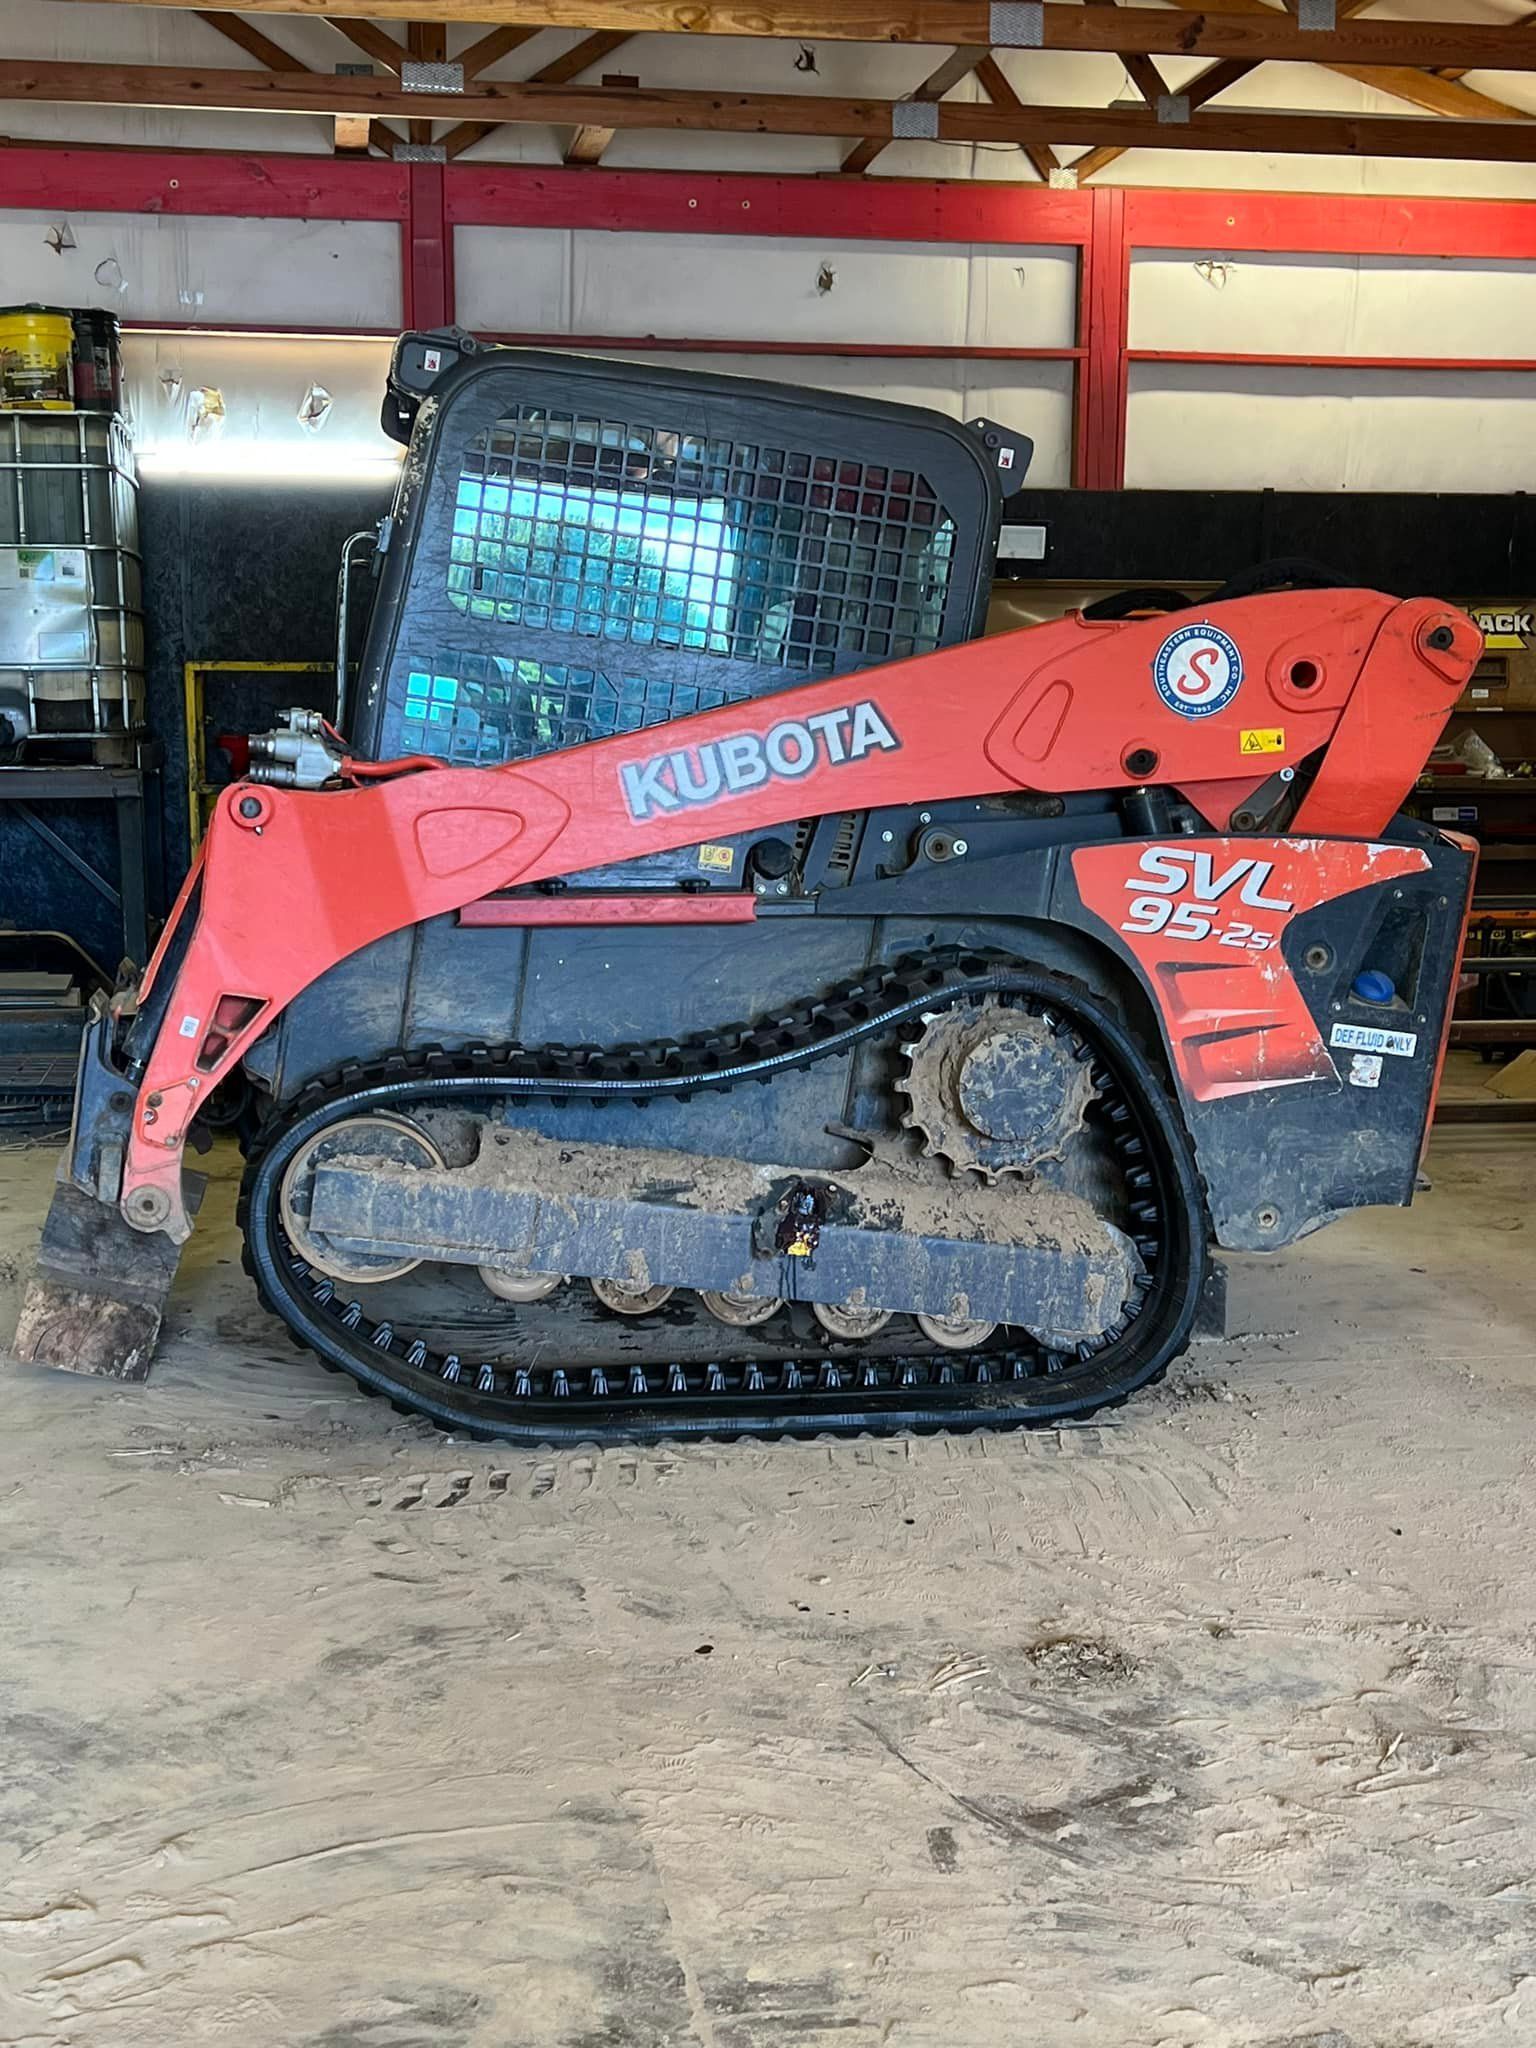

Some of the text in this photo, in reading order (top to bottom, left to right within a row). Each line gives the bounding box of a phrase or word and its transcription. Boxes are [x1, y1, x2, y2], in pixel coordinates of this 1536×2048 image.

[1472, 614, 1531, 633] ACK
[1158, 631, 1192, 698] SOUTHEASTERN
[1194, 628, 1238, 662] EQUIPMENT
[1177, 647, 1220, 696] S
[621, 701, 900, 819] KUBOTA
[1124, 846, 1294, 912] SVL
[1335, 1028, 1413, 1052] DEF FLUID ONLY
